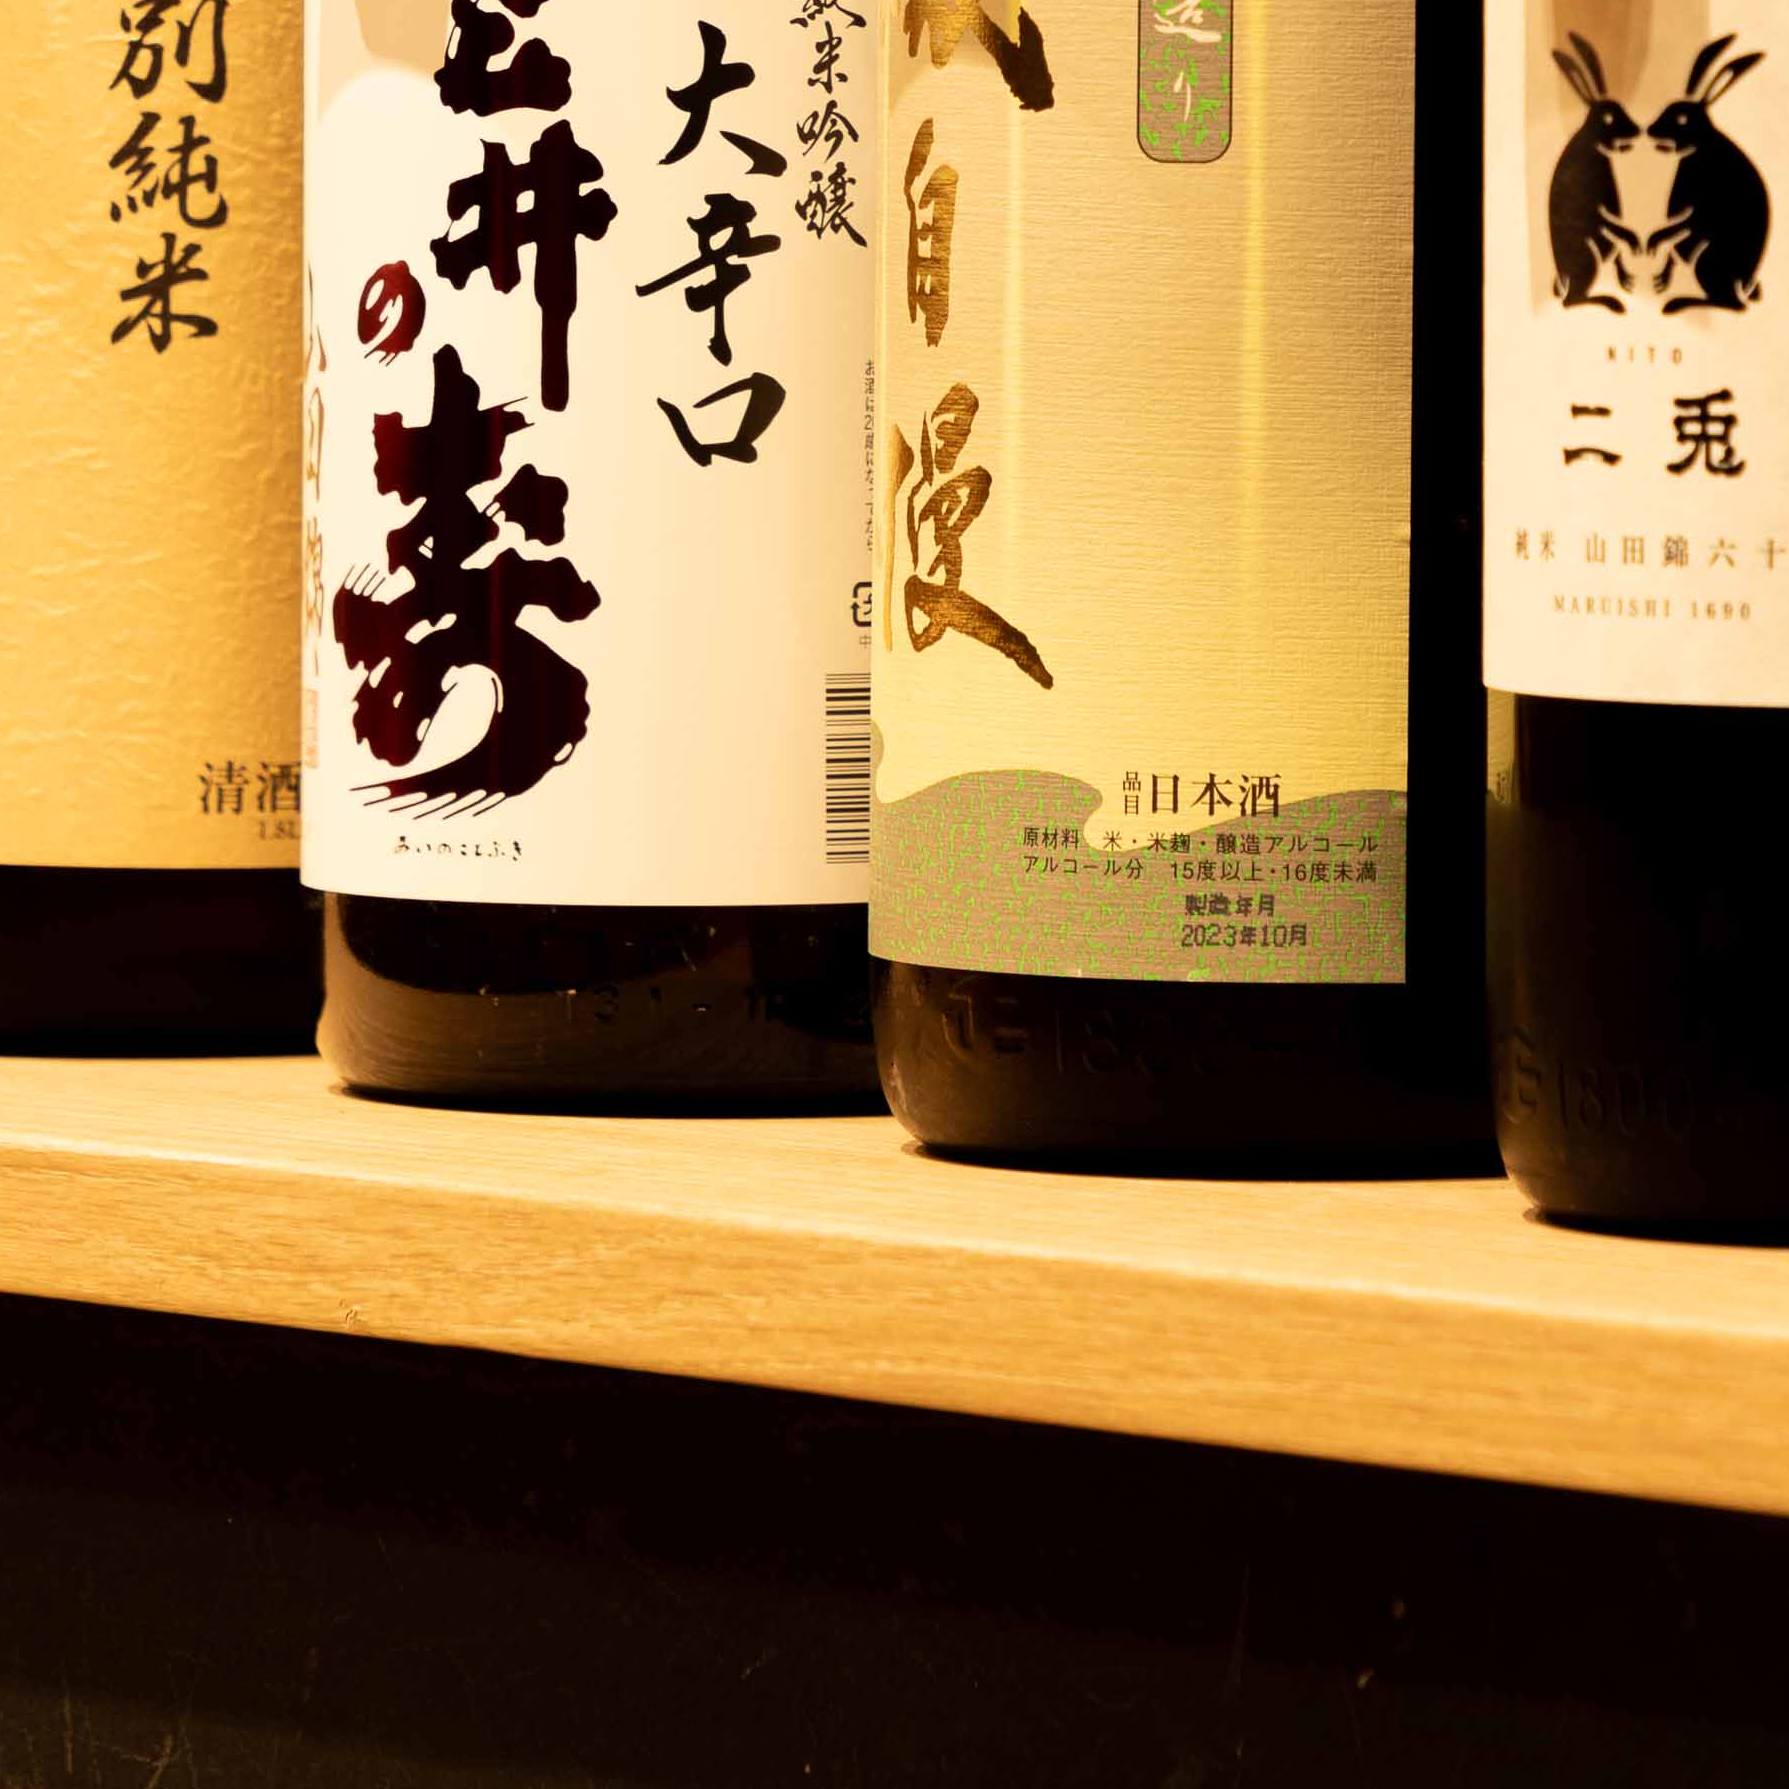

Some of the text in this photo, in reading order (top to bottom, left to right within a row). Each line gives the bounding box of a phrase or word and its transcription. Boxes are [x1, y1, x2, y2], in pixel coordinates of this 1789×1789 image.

[635, 20, 787, 467] 大辛口
[1607, 346, 1682, 365] NITO
[1554, 595, 1671, 618] MARUISHI
[198, 760, 301, 815] 清酒
[1123, 771, 1282, 817] 品目 日本酒
[1022, 826, 1080, 850] 原材料
[1023, 855, 1378, 884] アルコール分 15度以上・16度未満
[1184, 893, 1276, 918] 製造年月
[1180, 922, 1308, 949] 2023年10月
